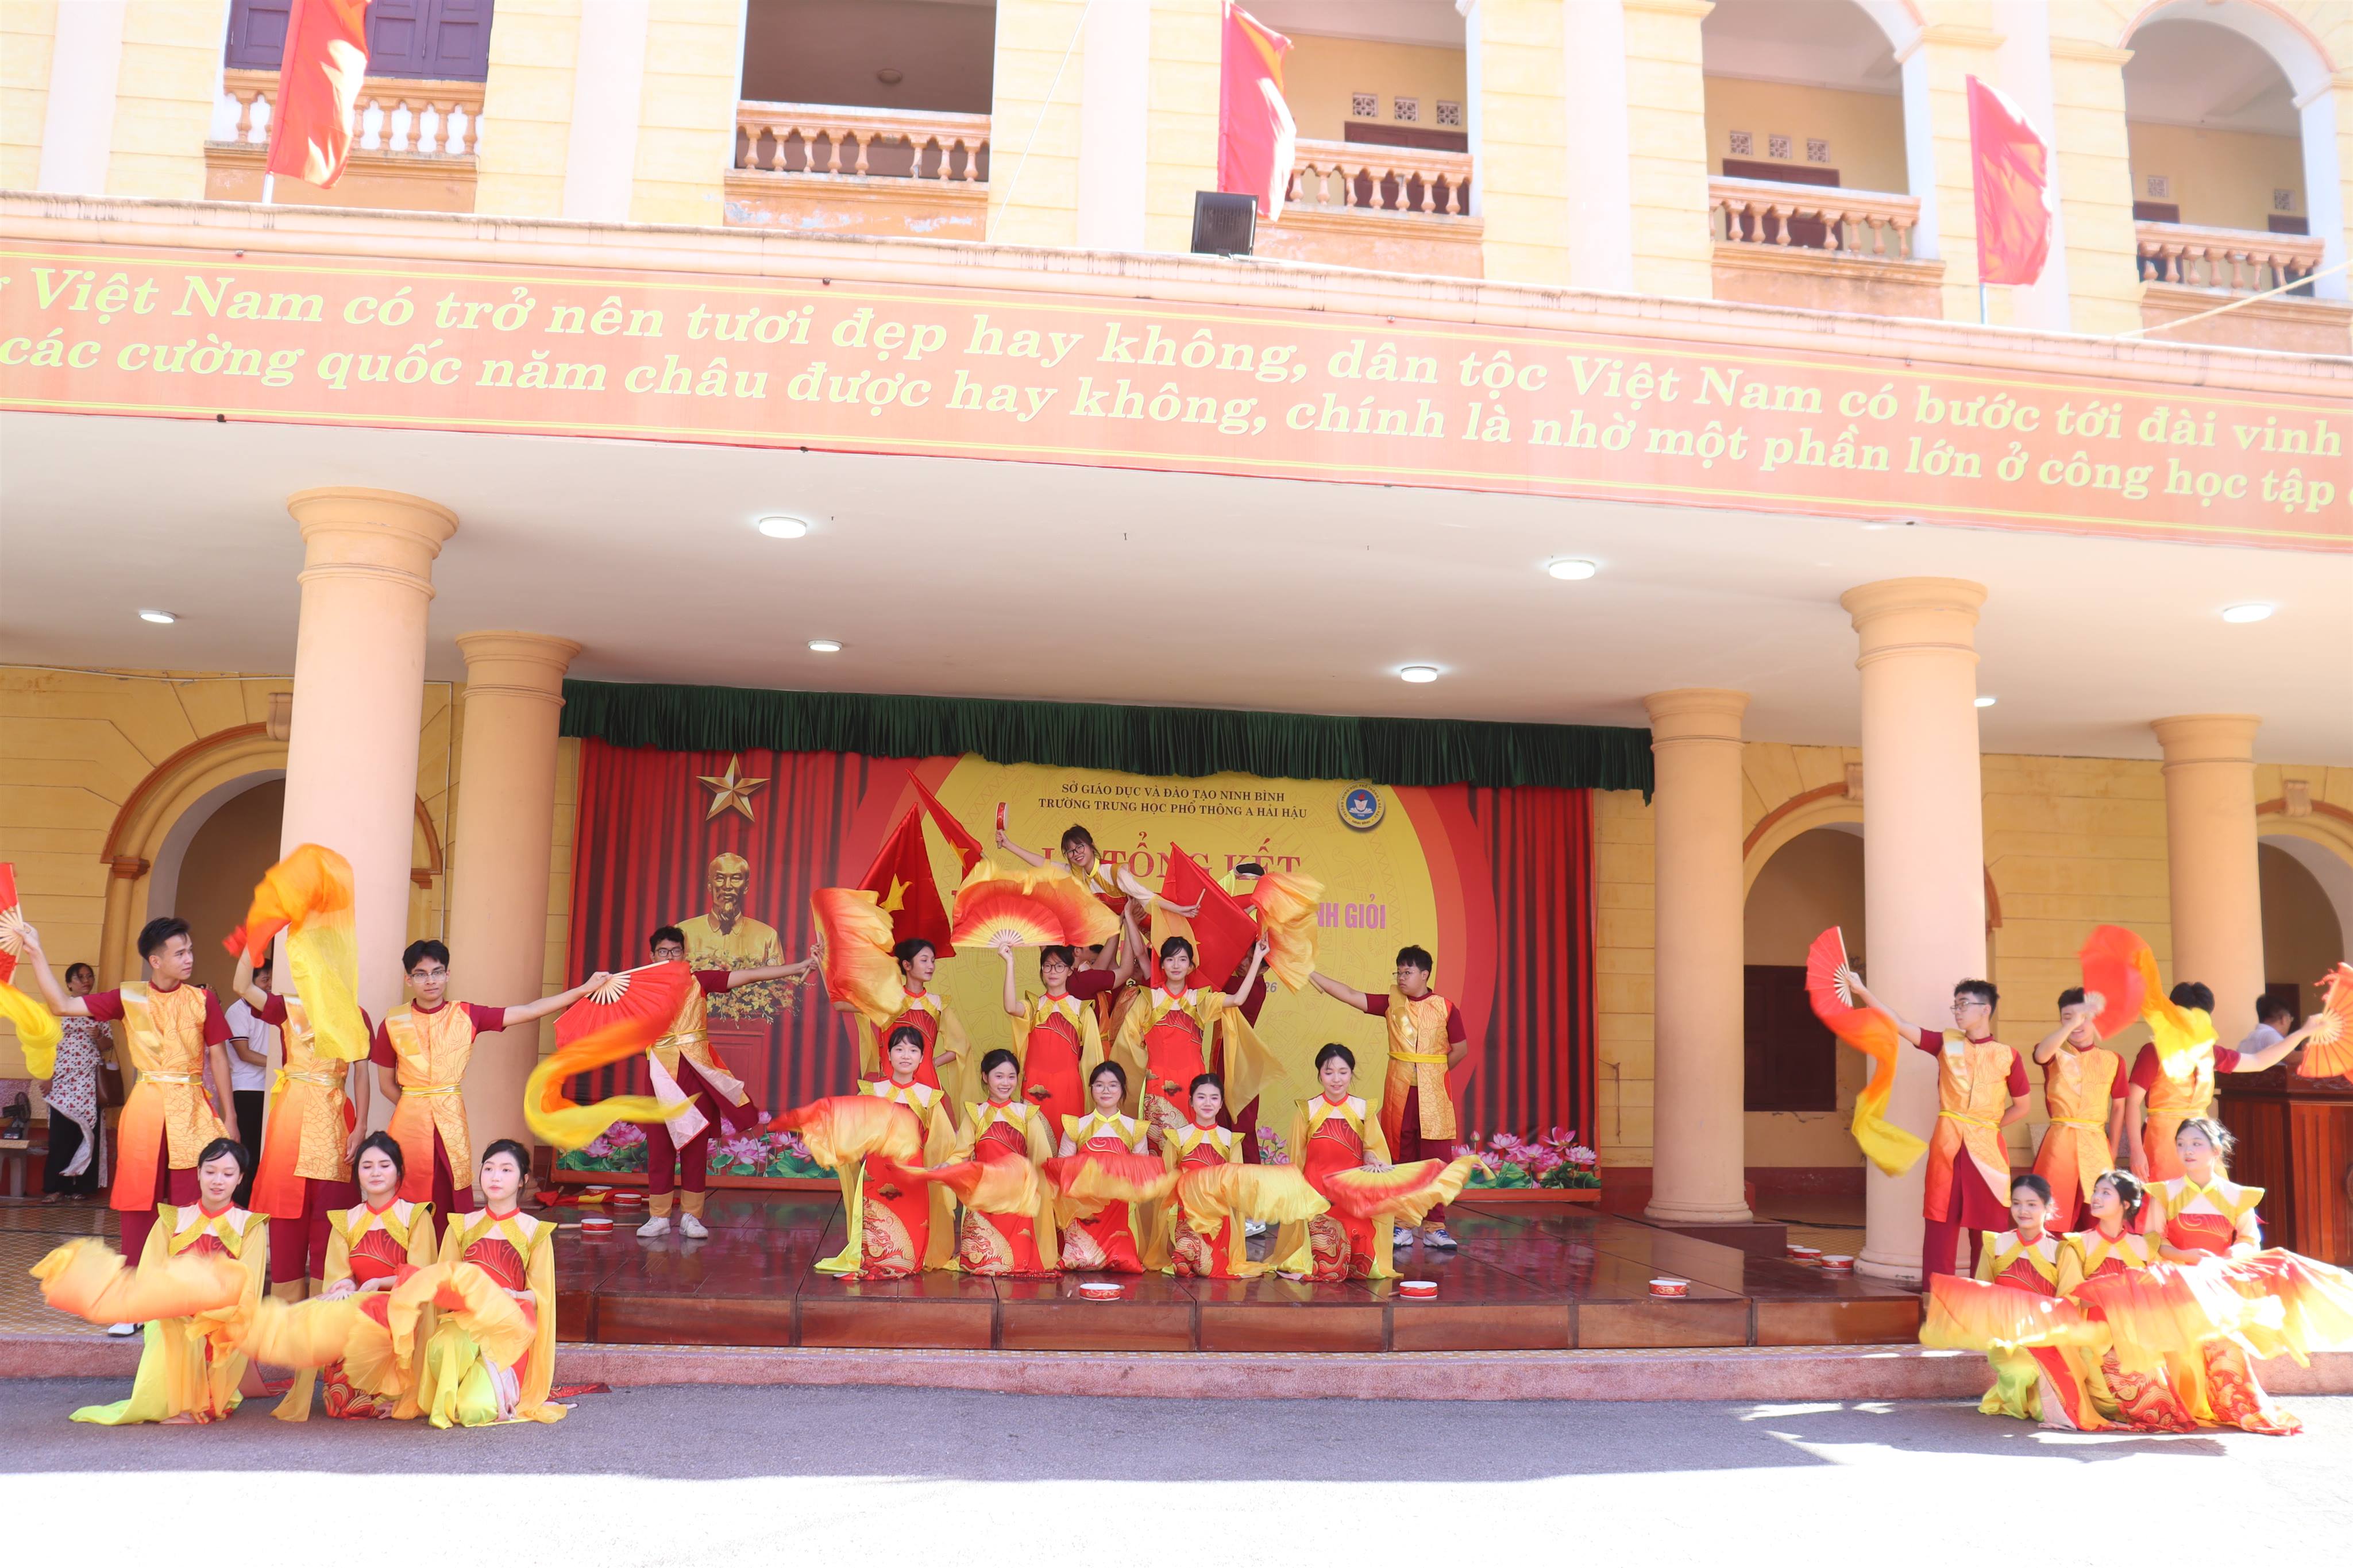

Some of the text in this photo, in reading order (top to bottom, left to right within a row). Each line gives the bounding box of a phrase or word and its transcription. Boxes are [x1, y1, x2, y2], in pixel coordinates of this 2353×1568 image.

[30, 268, 2341, 457] Việt Nam có trở nên tươi đẹp hay không, dân tộc Việt Nam có bước tới đài vinh
[0, 327, 2335, 513] các cường quốc năm châu được hay không, chính là nhờ một phần lớn ở công học tập
[1038, 797, 1307, 820] TRƯỜNG TRUNG HỌC PHỔ THÔNG A HẢI HẬU
[1062, 781, 1284, 802] SỞ GIÁO DỤC VÀ ĐÀO TẠO NINH BÌNH
[1345, 894, 1386, 929] GIỎI
